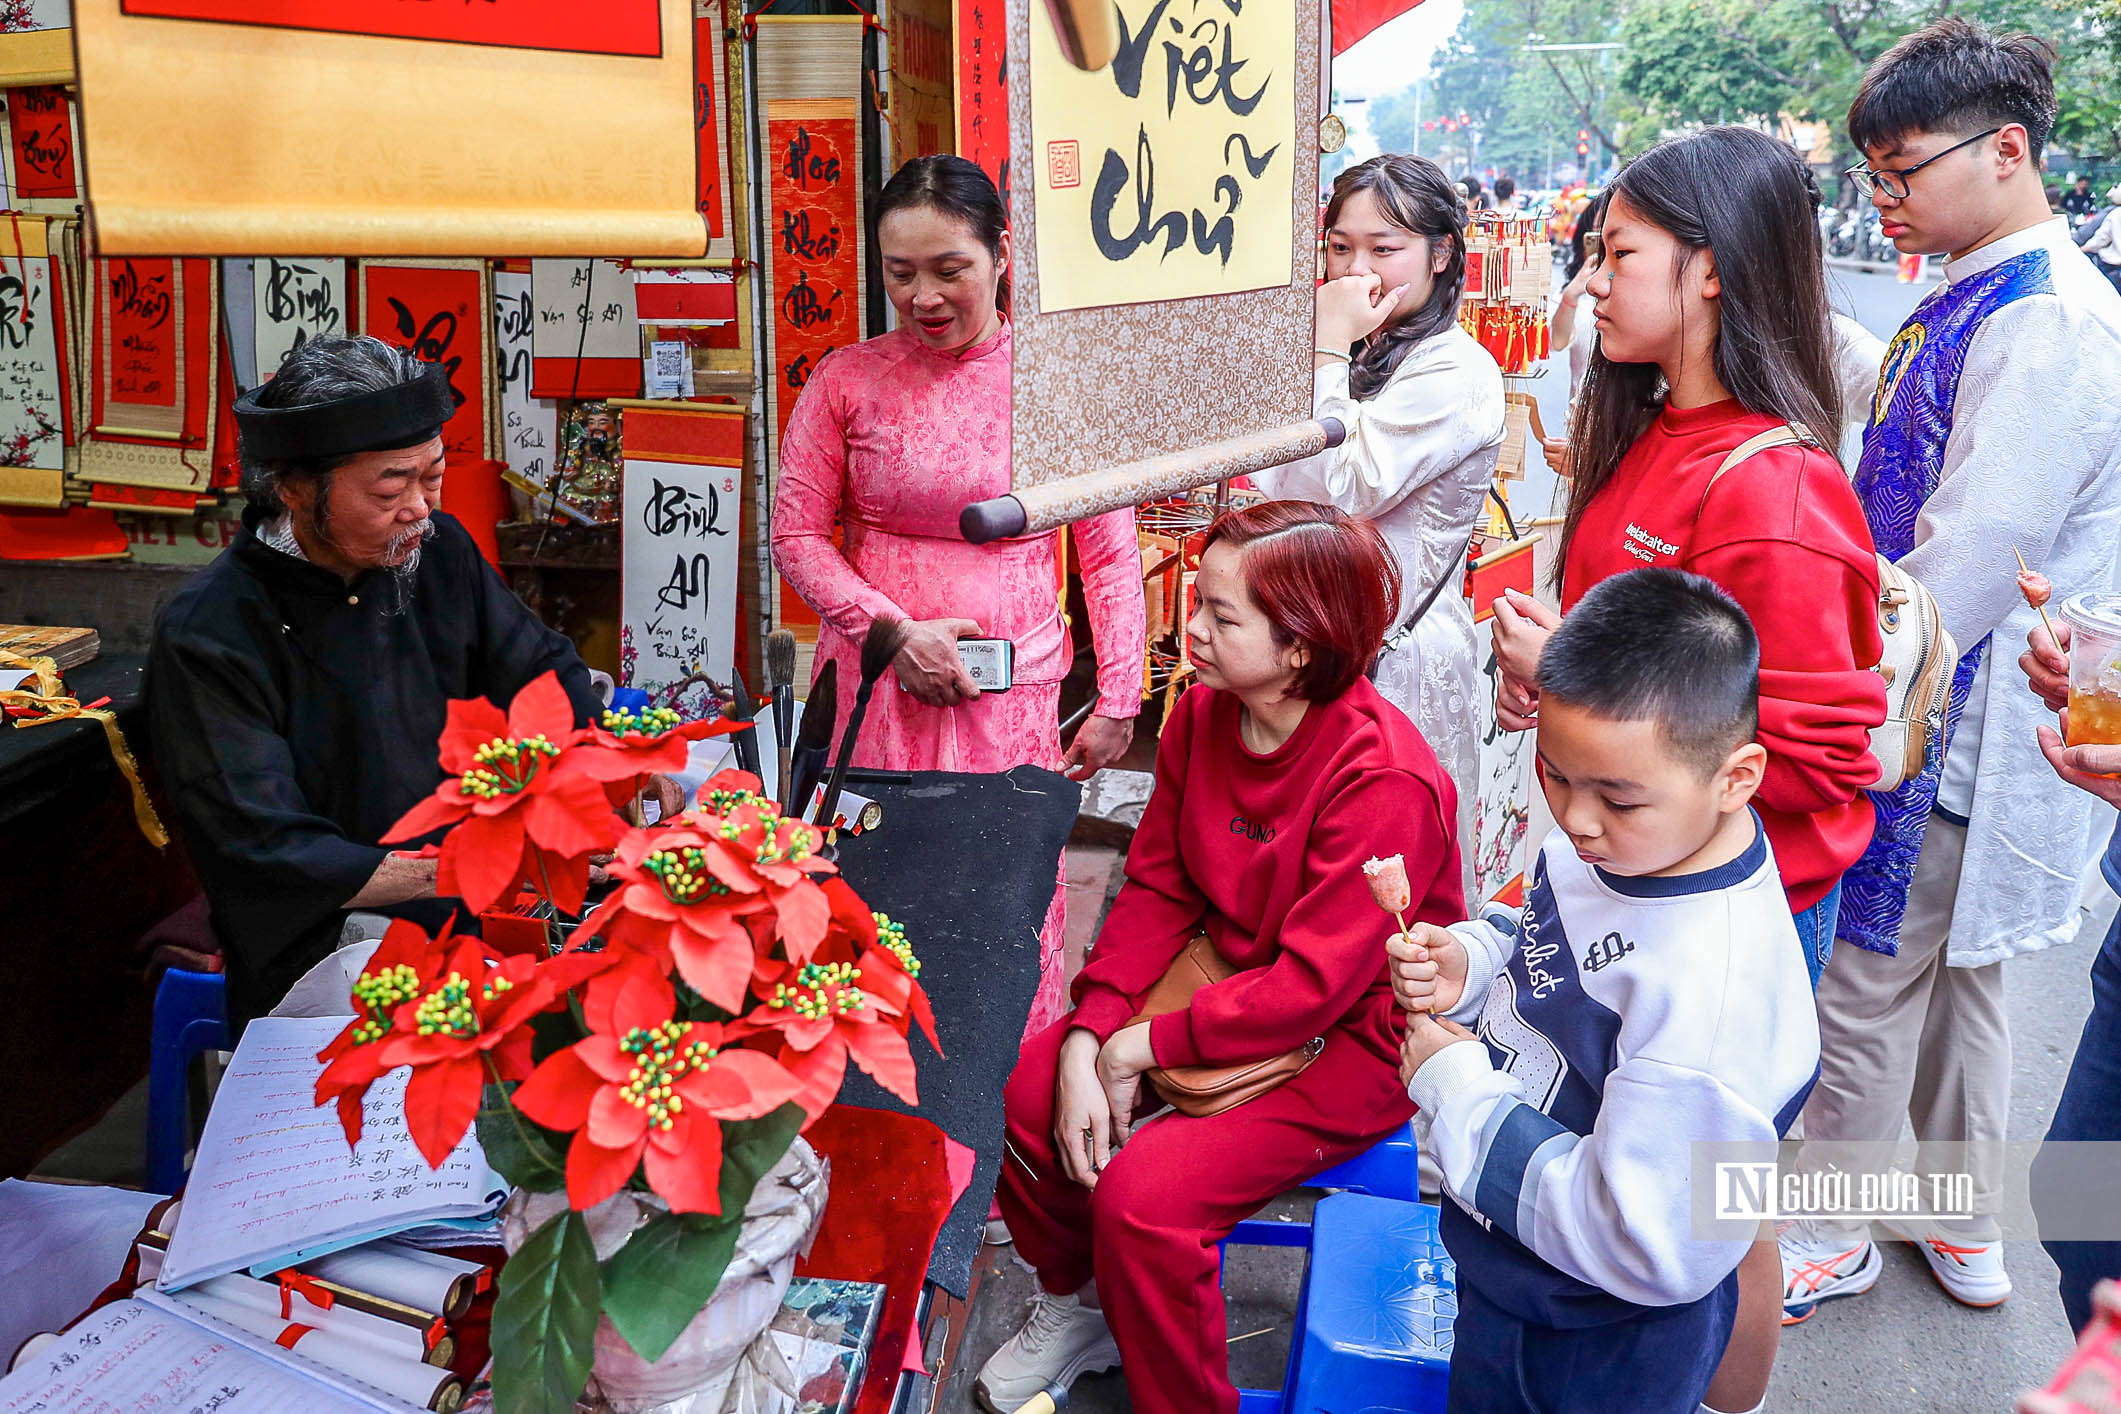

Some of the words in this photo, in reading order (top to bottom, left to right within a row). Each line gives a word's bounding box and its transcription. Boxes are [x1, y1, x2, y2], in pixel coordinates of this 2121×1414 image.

[783, 126, 840, 190] Hoa
[1091, 122, 1281, 277] Chữ
[780, 209, 839, 261] Khai
[265, 257, 339, 334] Bình
[643, 477, 730, 541] Bình
[645, 615, 673, 641] Vạn
